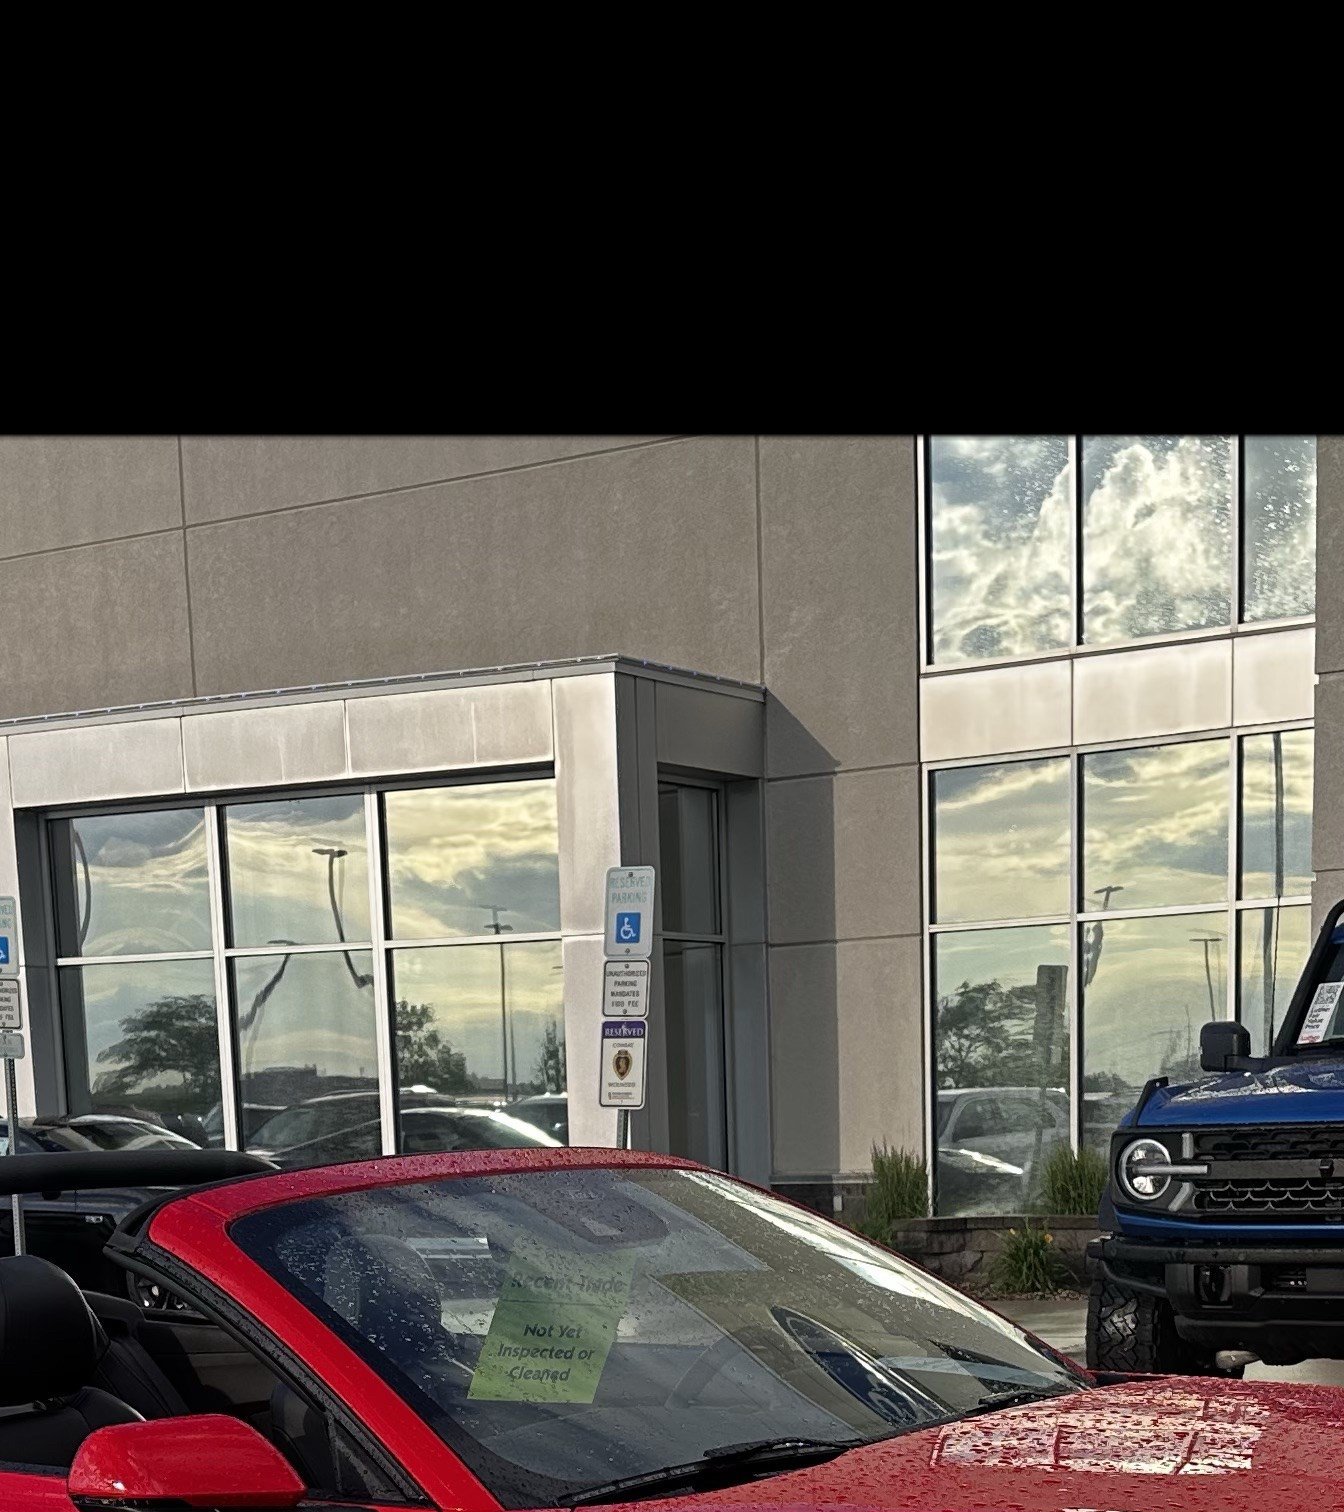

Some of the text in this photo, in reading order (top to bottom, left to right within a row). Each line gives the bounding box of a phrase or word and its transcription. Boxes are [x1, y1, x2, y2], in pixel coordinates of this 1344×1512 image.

[611, 892, 647, 904] PARKING
[604, 1028, 644, 1037] RESERVED
[523, 1323, 583, 1339] Not Yet
[497, 1343, 595, 1361] Inspected or
